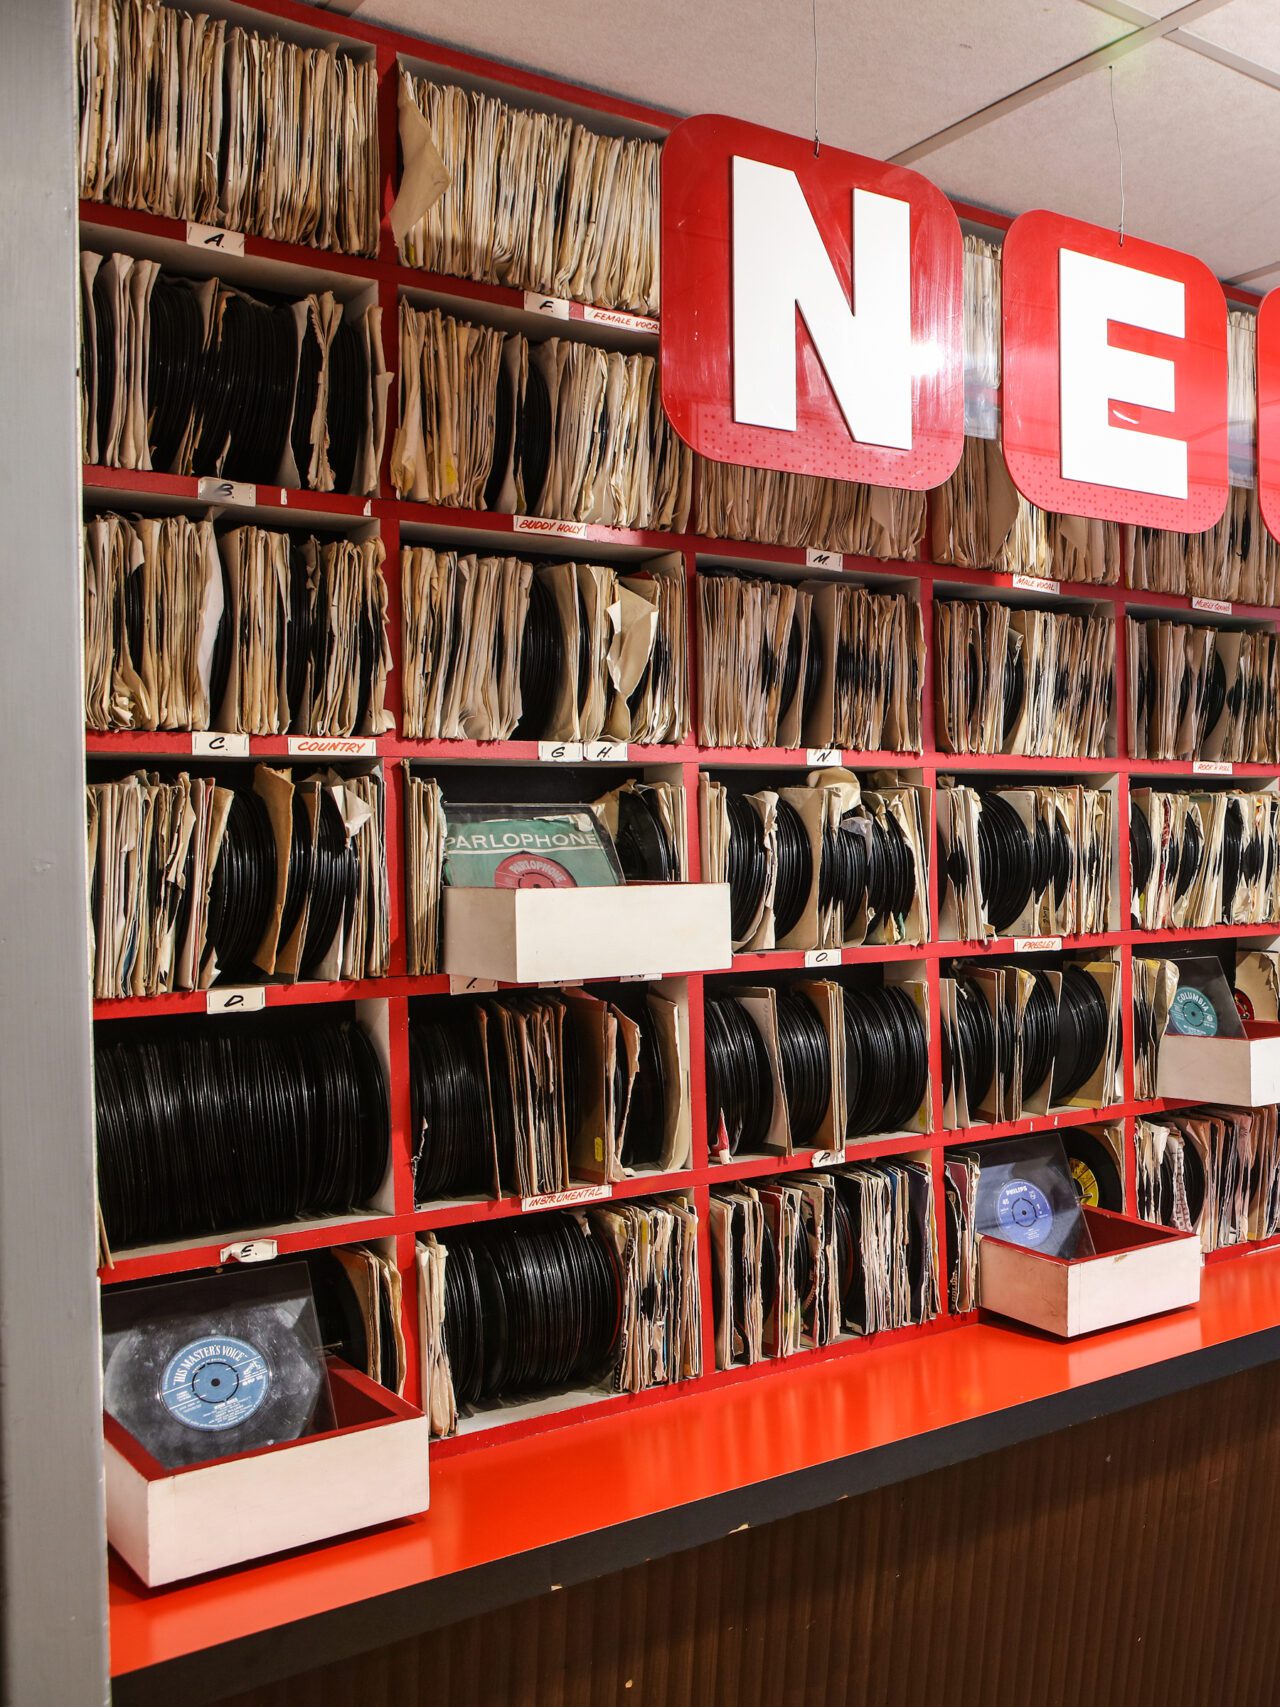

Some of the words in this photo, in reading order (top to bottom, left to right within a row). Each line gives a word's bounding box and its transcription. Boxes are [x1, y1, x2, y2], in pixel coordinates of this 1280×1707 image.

[593, 311, 632, 326] FEMALE
[635, 320, 659, 331] VOCA
[519, 519, 555, 532] BUDDY
[556, 522, 584, 535] HOLLY
[297, 741, 366, 754] COUNTRY
[446, 833, 599, 849] PARLOPHONE
[509, 861, 567, 883] PARLOPHONE
[1022, 940, 1057, 950] PRESLEY
[1177, 992, 1209, 1012] COLUMBIA
[528, 1186, 603, 1208] INSTRUMENTAL
[1006, 1185, 1028, 1196] PHILIPS
[185, 1345, 221, 1372] MASTER'S
